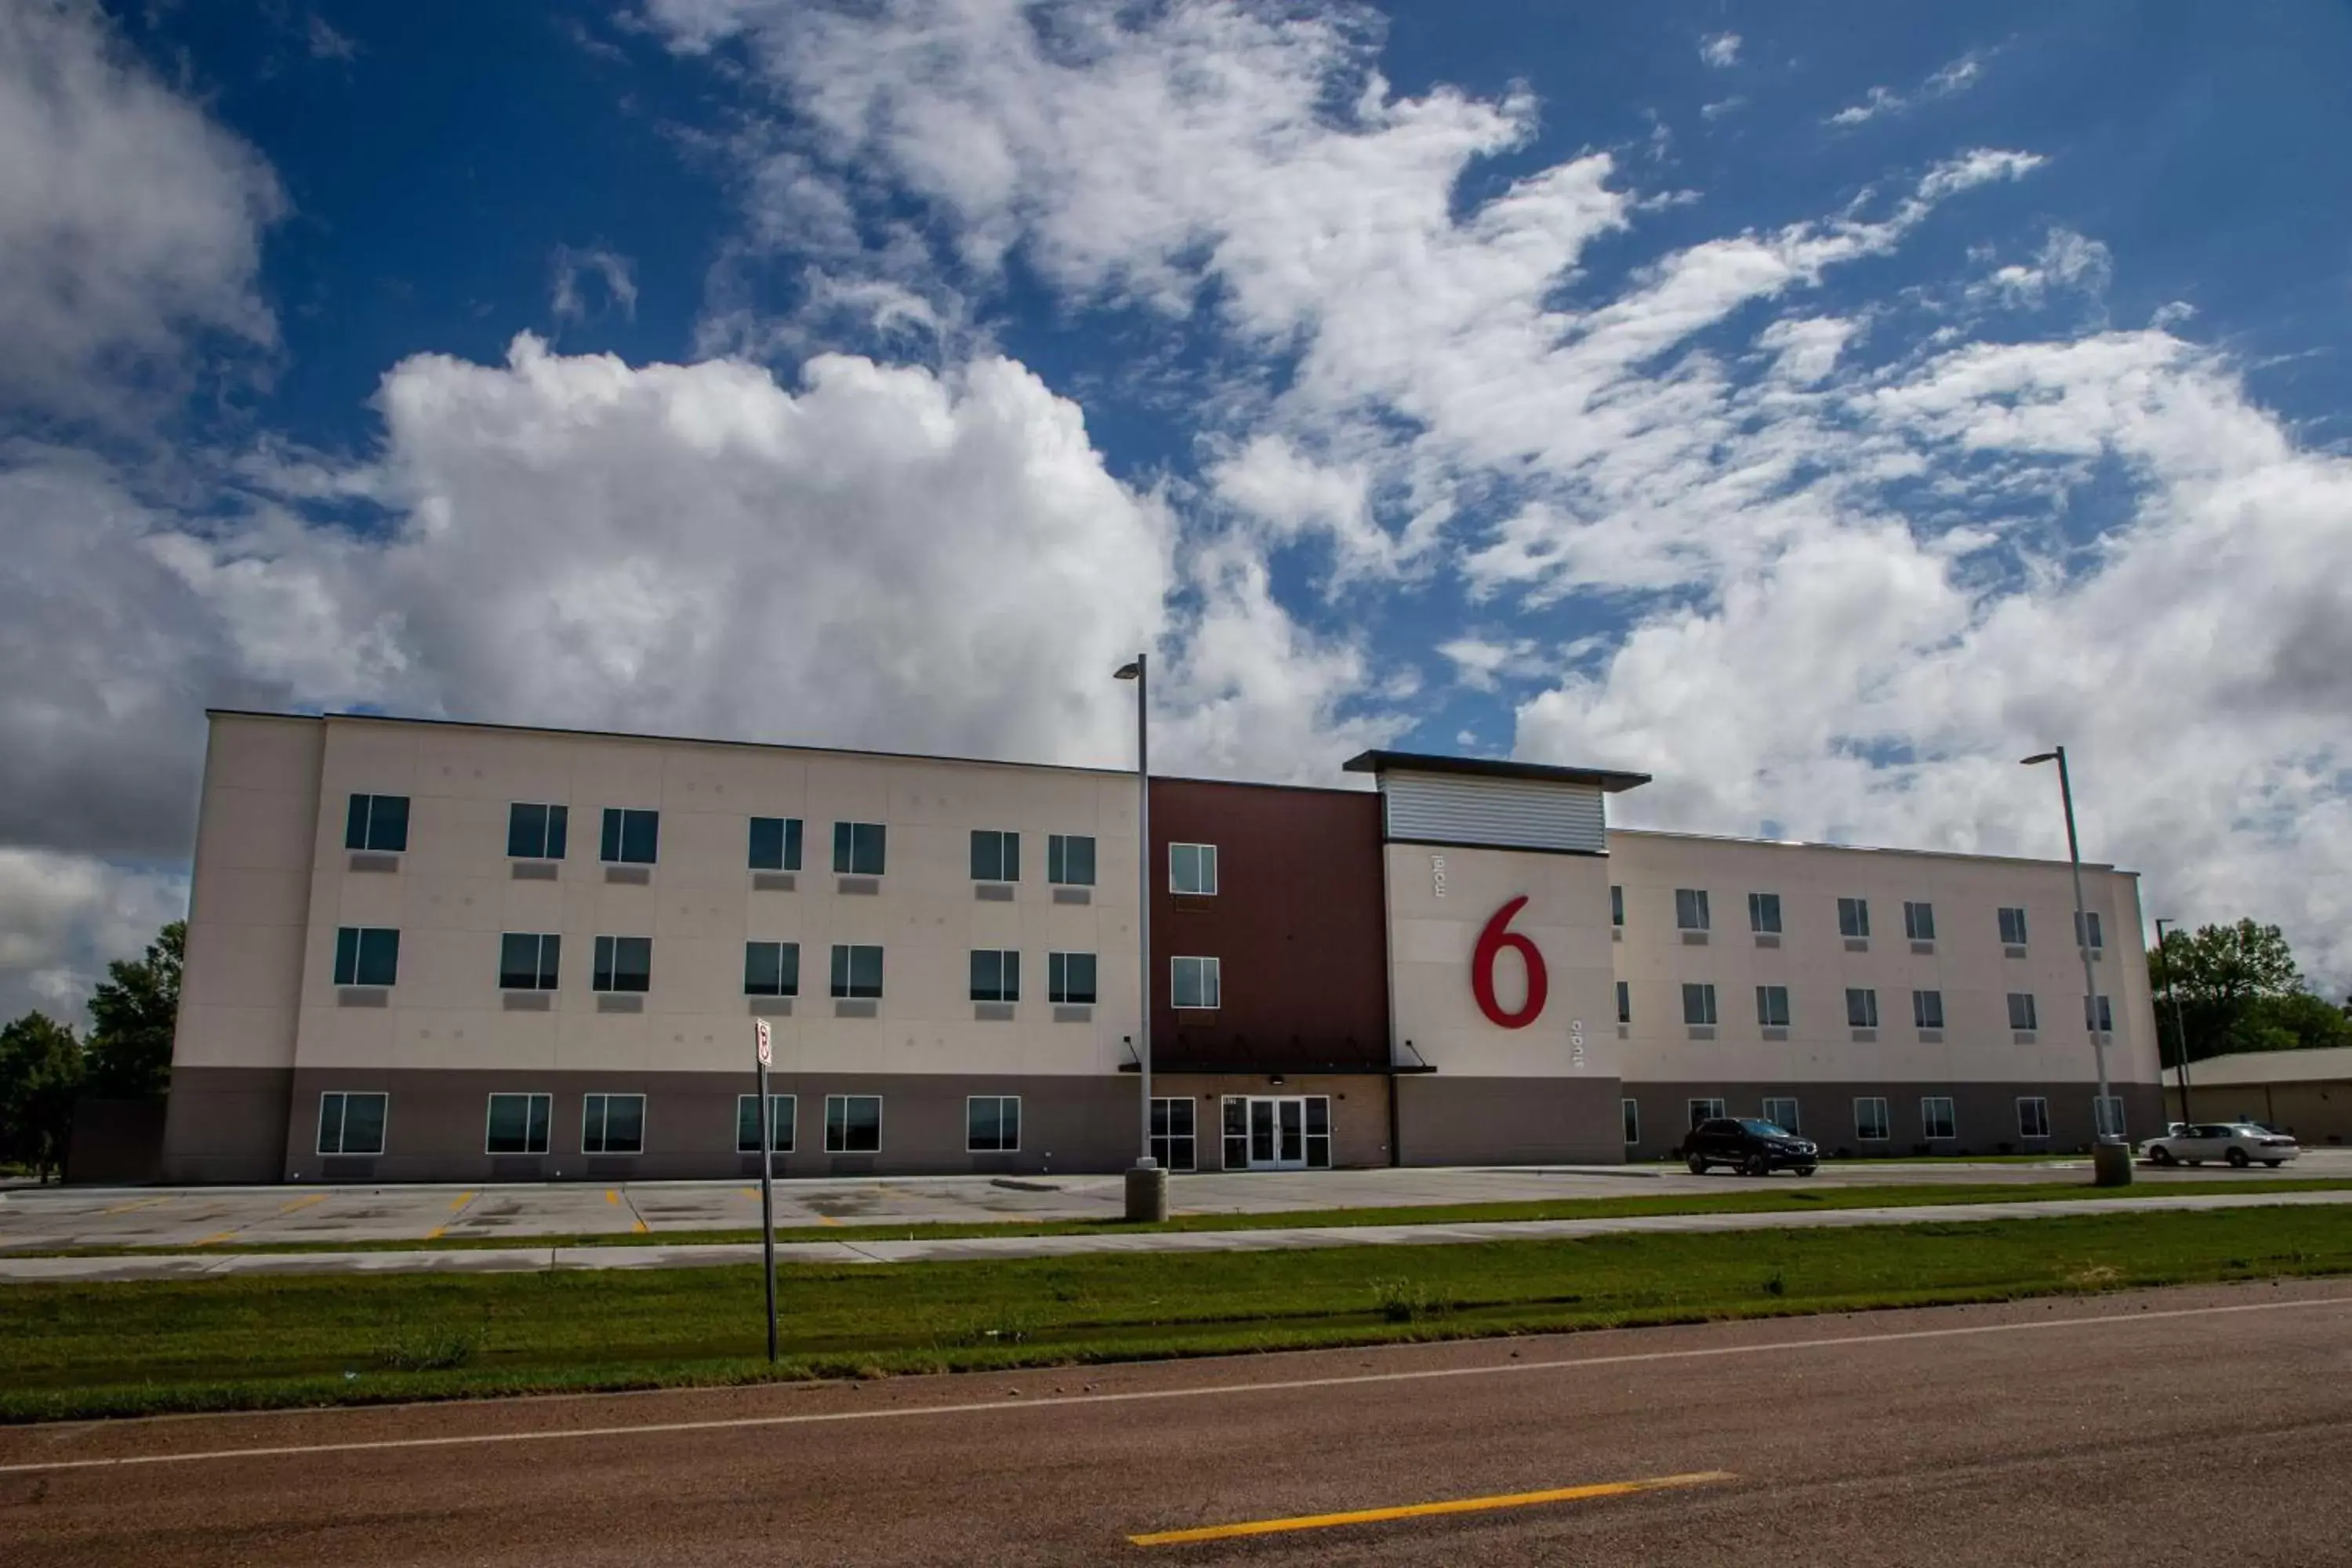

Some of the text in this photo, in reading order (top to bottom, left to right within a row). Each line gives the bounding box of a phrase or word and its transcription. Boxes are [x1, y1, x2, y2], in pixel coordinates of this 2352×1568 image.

[1431, 855, 1446, 897] motel
[1472, 895, 1548, 1029] 6
[1570, 1020, 1584, 1068] studio
